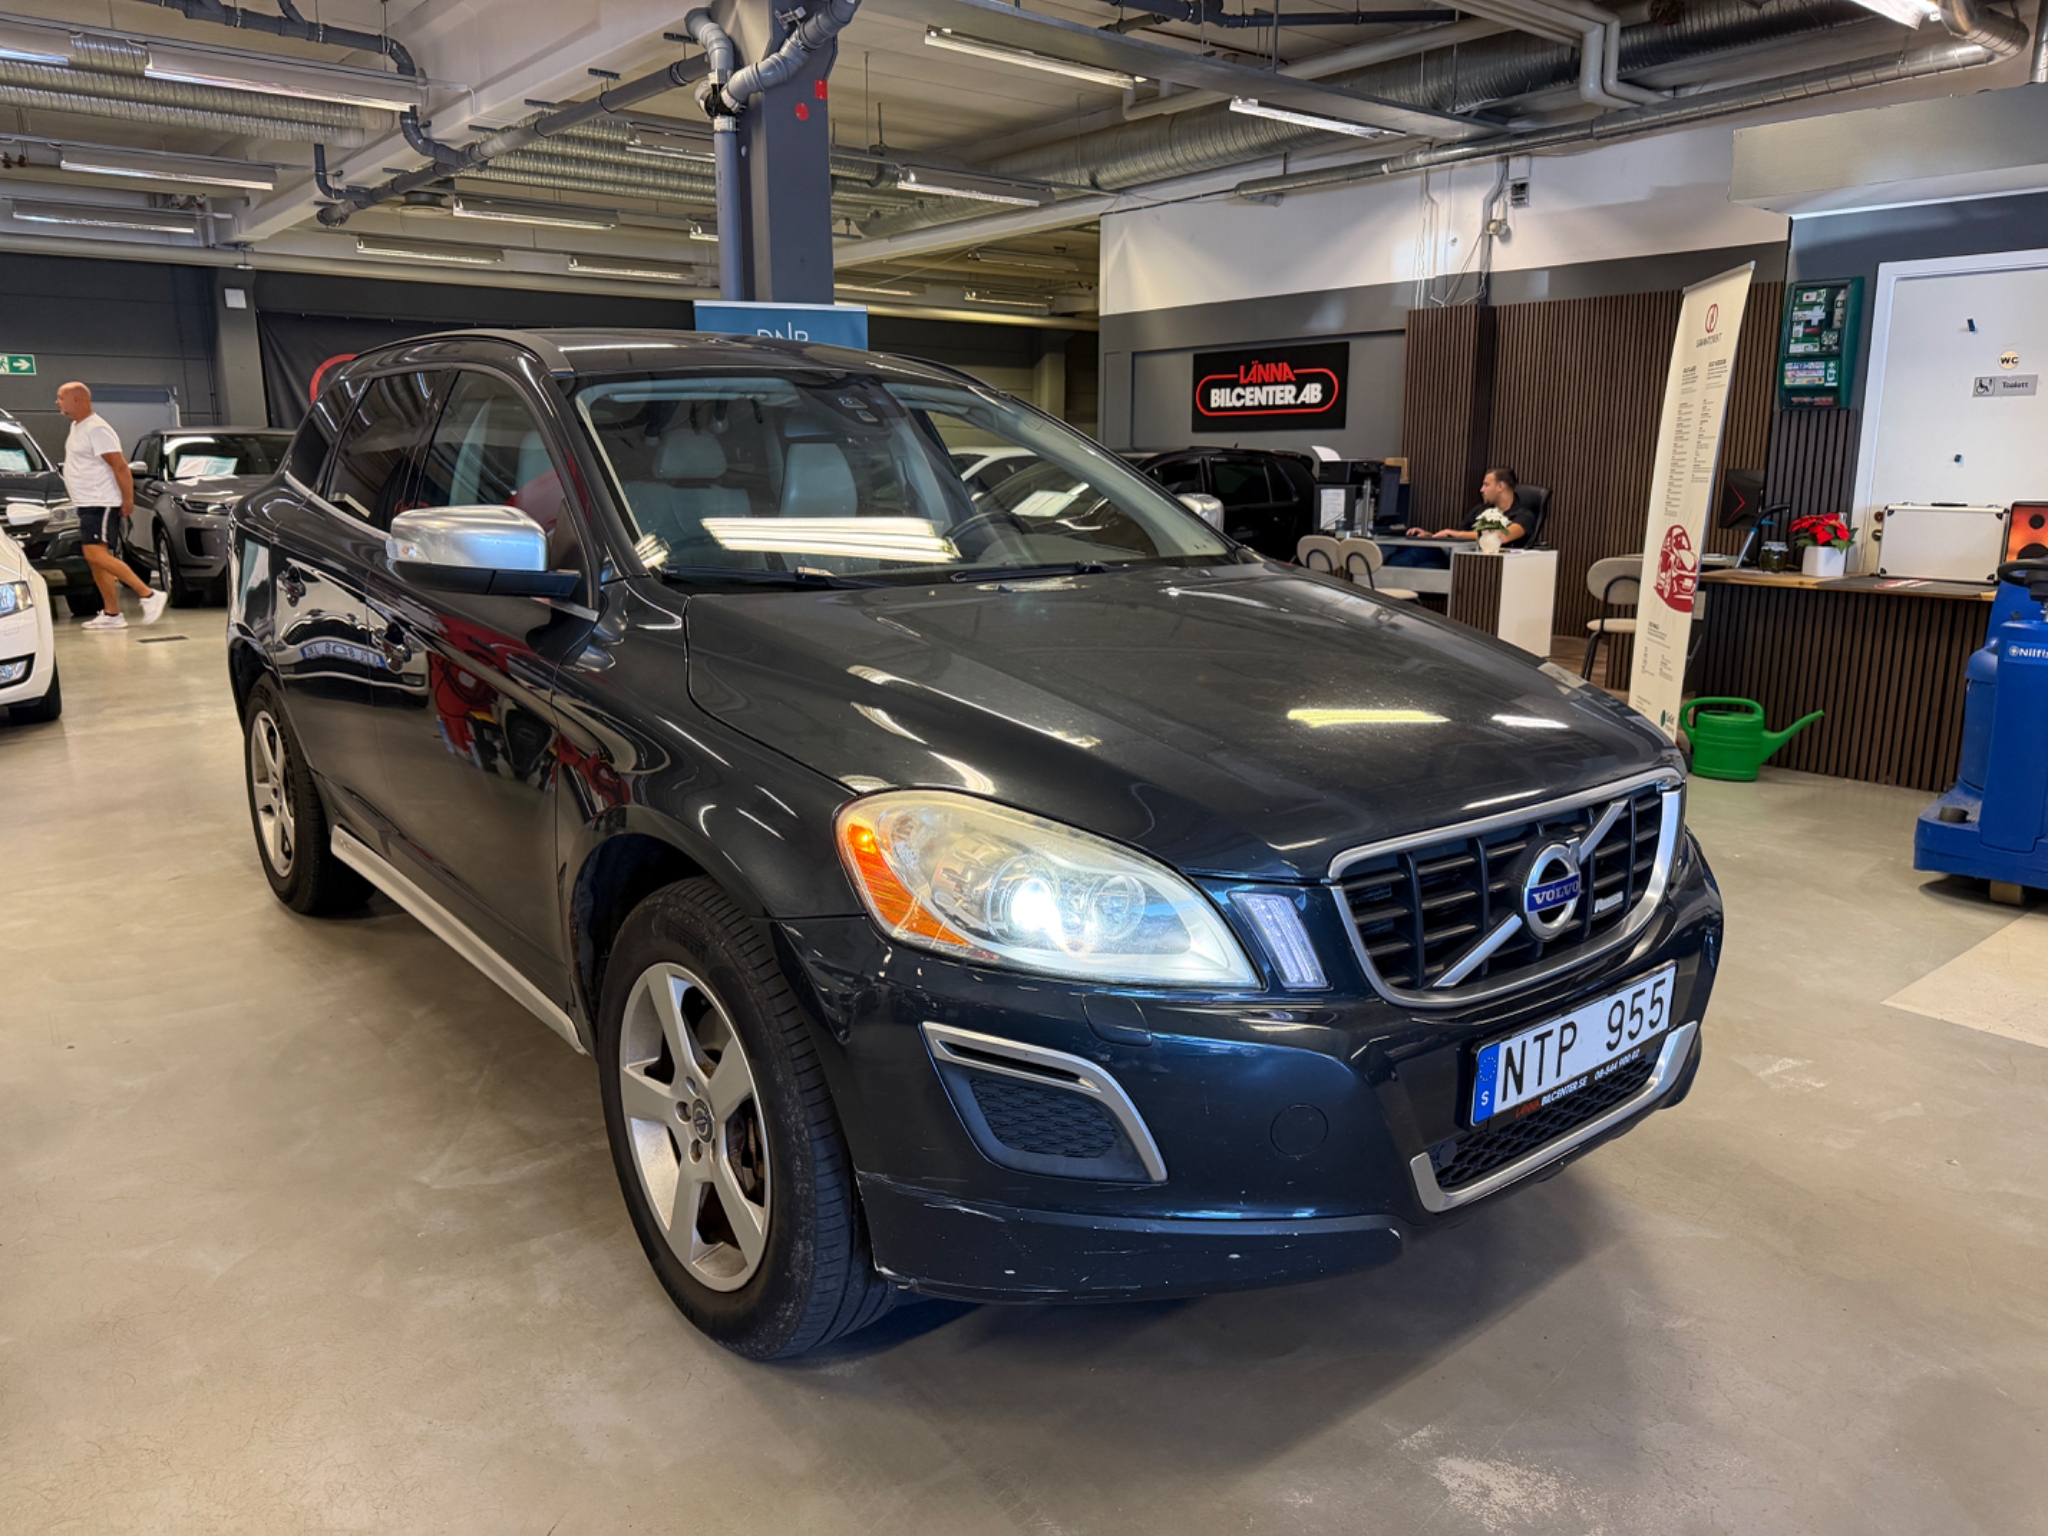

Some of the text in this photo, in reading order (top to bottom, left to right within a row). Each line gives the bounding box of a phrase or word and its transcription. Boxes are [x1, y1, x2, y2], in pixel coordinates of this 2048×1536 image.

[1239, 360, 1297, 384] LÄNNA
[2000, 356, 2019, 365] WC
[1210, 383, 1322, 408] BILCENTER AB
[1532, 880, 1580, 905] VOLVO
[1502, 977, 1667, 1103] NTP 955
[1481, 1090, 1490, 1107] S
